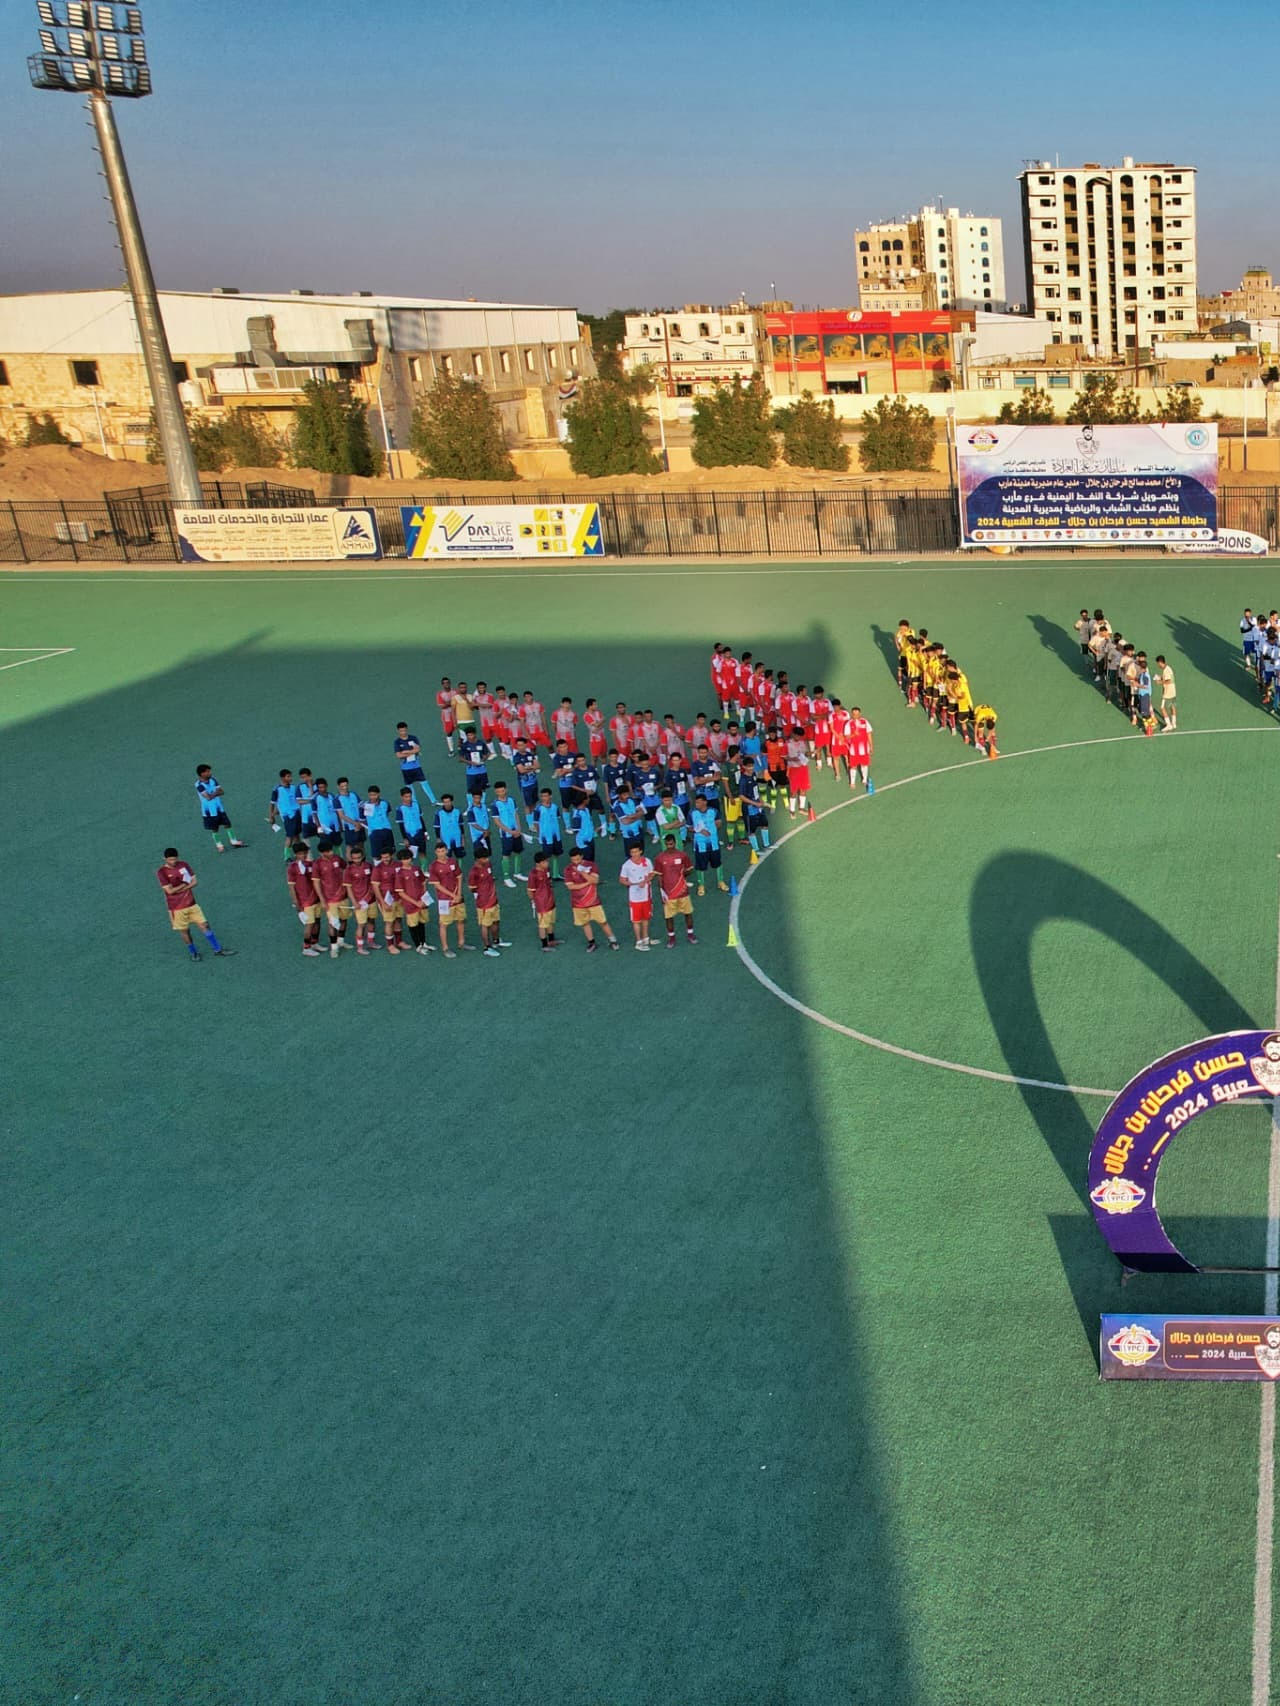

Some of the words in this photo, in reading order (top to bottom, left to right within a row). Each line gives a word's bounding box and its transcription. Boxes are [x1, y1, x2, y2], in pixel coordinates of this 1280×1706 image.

[1002, 490, 1023, 502] مأرب
[1024, 492, 1045, 502] فرع
[1047, 491, 1074, 502] اليمنية
[1076, 492, 1104, 501] النفط
[1105, 490, 1139, 502] شركة
[1002, 503, 1031, 514] المدينة
[1103, 503, 1131, 514] الشباب
[1133, 504, 1157, 514] مكتب
[183, 514, 216, 524] العامة
[218, 513, 269, 525] والخدمات
[271, 513, 305, 525] للتجارة
[306, 512, 329, 524] عمار
[977, 518, 1000, 526] 2024
[1067, 517, 1086, 526] جلال
[1088, 517, 1098, 526] بن
[1100, 516, 1124, 526] فرحان
[1126, 516, 1147, 527] حسن
[1149, 515, 1180, 526] الشهيد
[1181, 515, 1207, 526] بطولة
[1193, 1051, 1247, 1081] حسن
[1140, 1069, 1194, 1116] فرحان
[1165, 1092, 1209, 1130] 2024
[1124, 1110, 1151, 1134] بن
[1103, 1134, 1134, 1175] جلال
[1169, 1332, 1191, 1344] جلال
[1193, 1332, 1205, 1345] بن
[1206, 1332, 1234, 1345] فرحان
[1236, 1332, 1261, 1345] حسن
[1202, 1349, 1225, 1358] 2024
